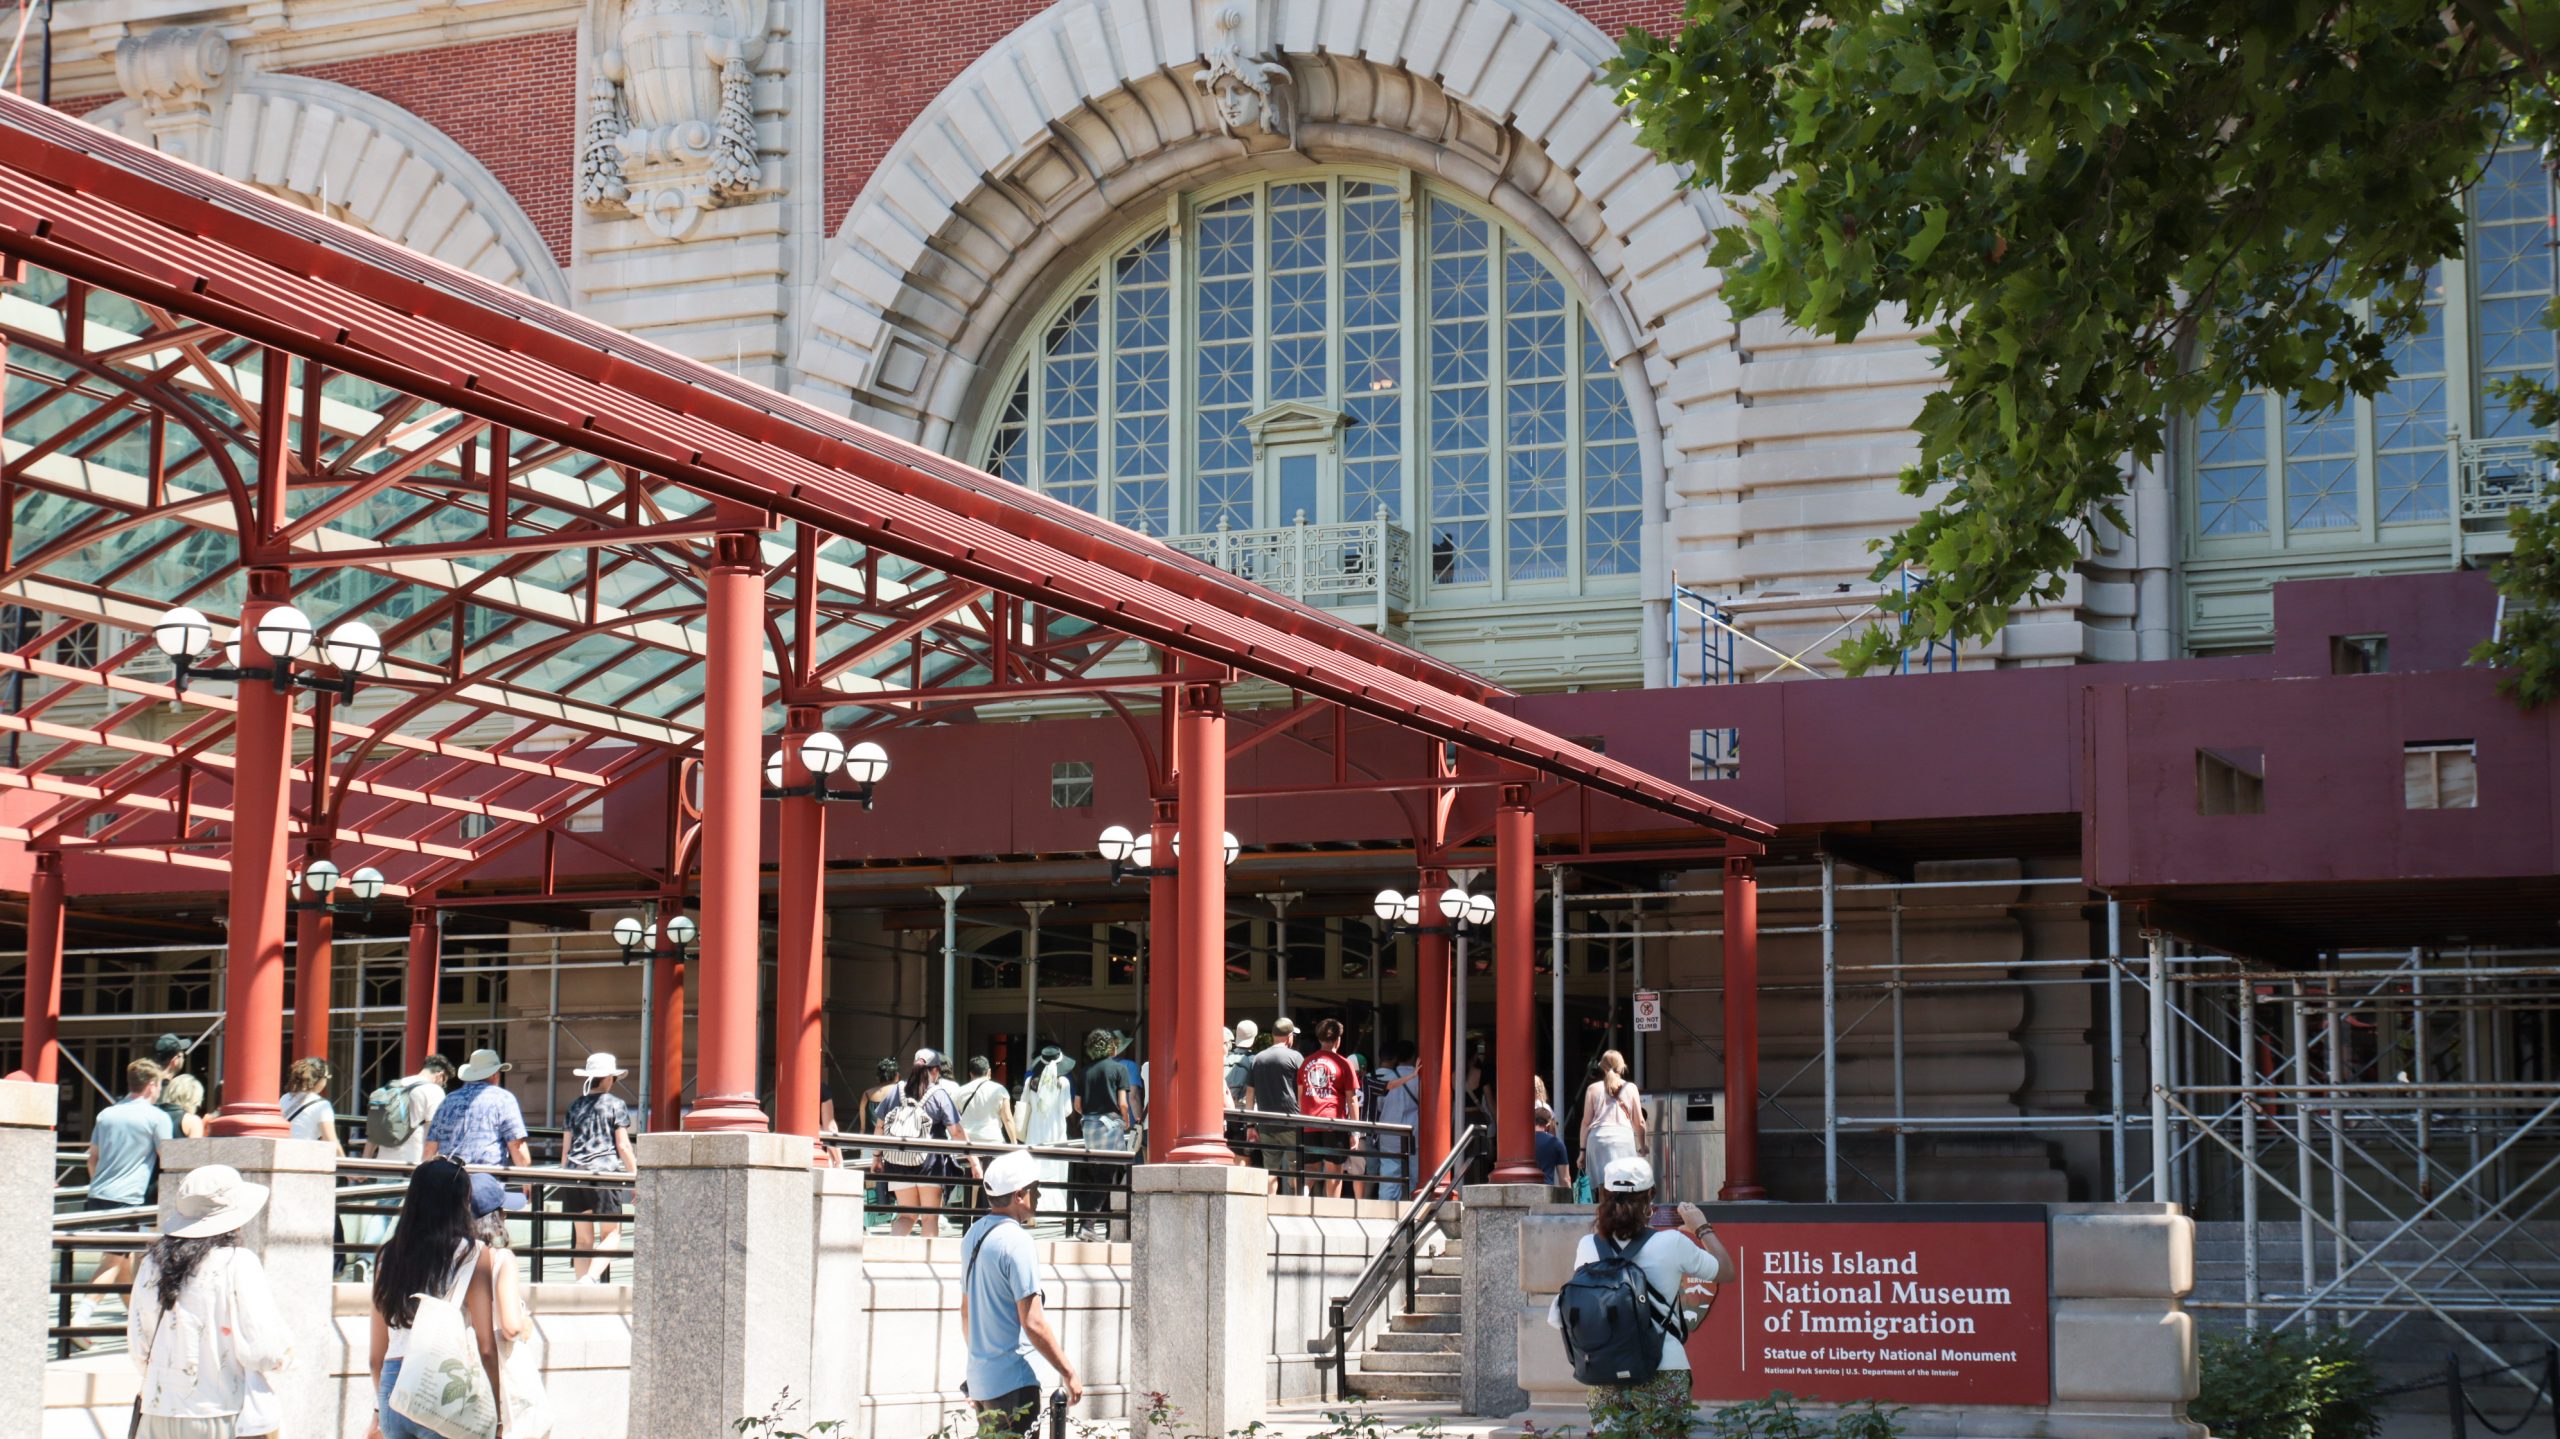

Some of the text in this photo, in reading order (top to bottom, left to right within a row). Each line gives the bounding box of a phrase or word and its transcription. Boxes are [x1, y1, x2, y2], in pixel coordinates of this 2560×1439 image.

[1763, 1250, 1918, 1275] Ellis Island
[1762, 1280, 2012, 1305] National Museum
[1763, 1308, 1976, 1340] of Immigration
[1763, 1347, 2017, 1364] Statue of Liberty National Monument
[1764, 1367, 1795, 1375] National
[1796, 1367, 1813, 1375] Park
[1814, 1367, 1840, 1375] Service
[1862, 1368, 1906, 1377] Department
[1907, 1368, 1916, 1376] of
[1931, 1369, 1960, 1377] Interior
